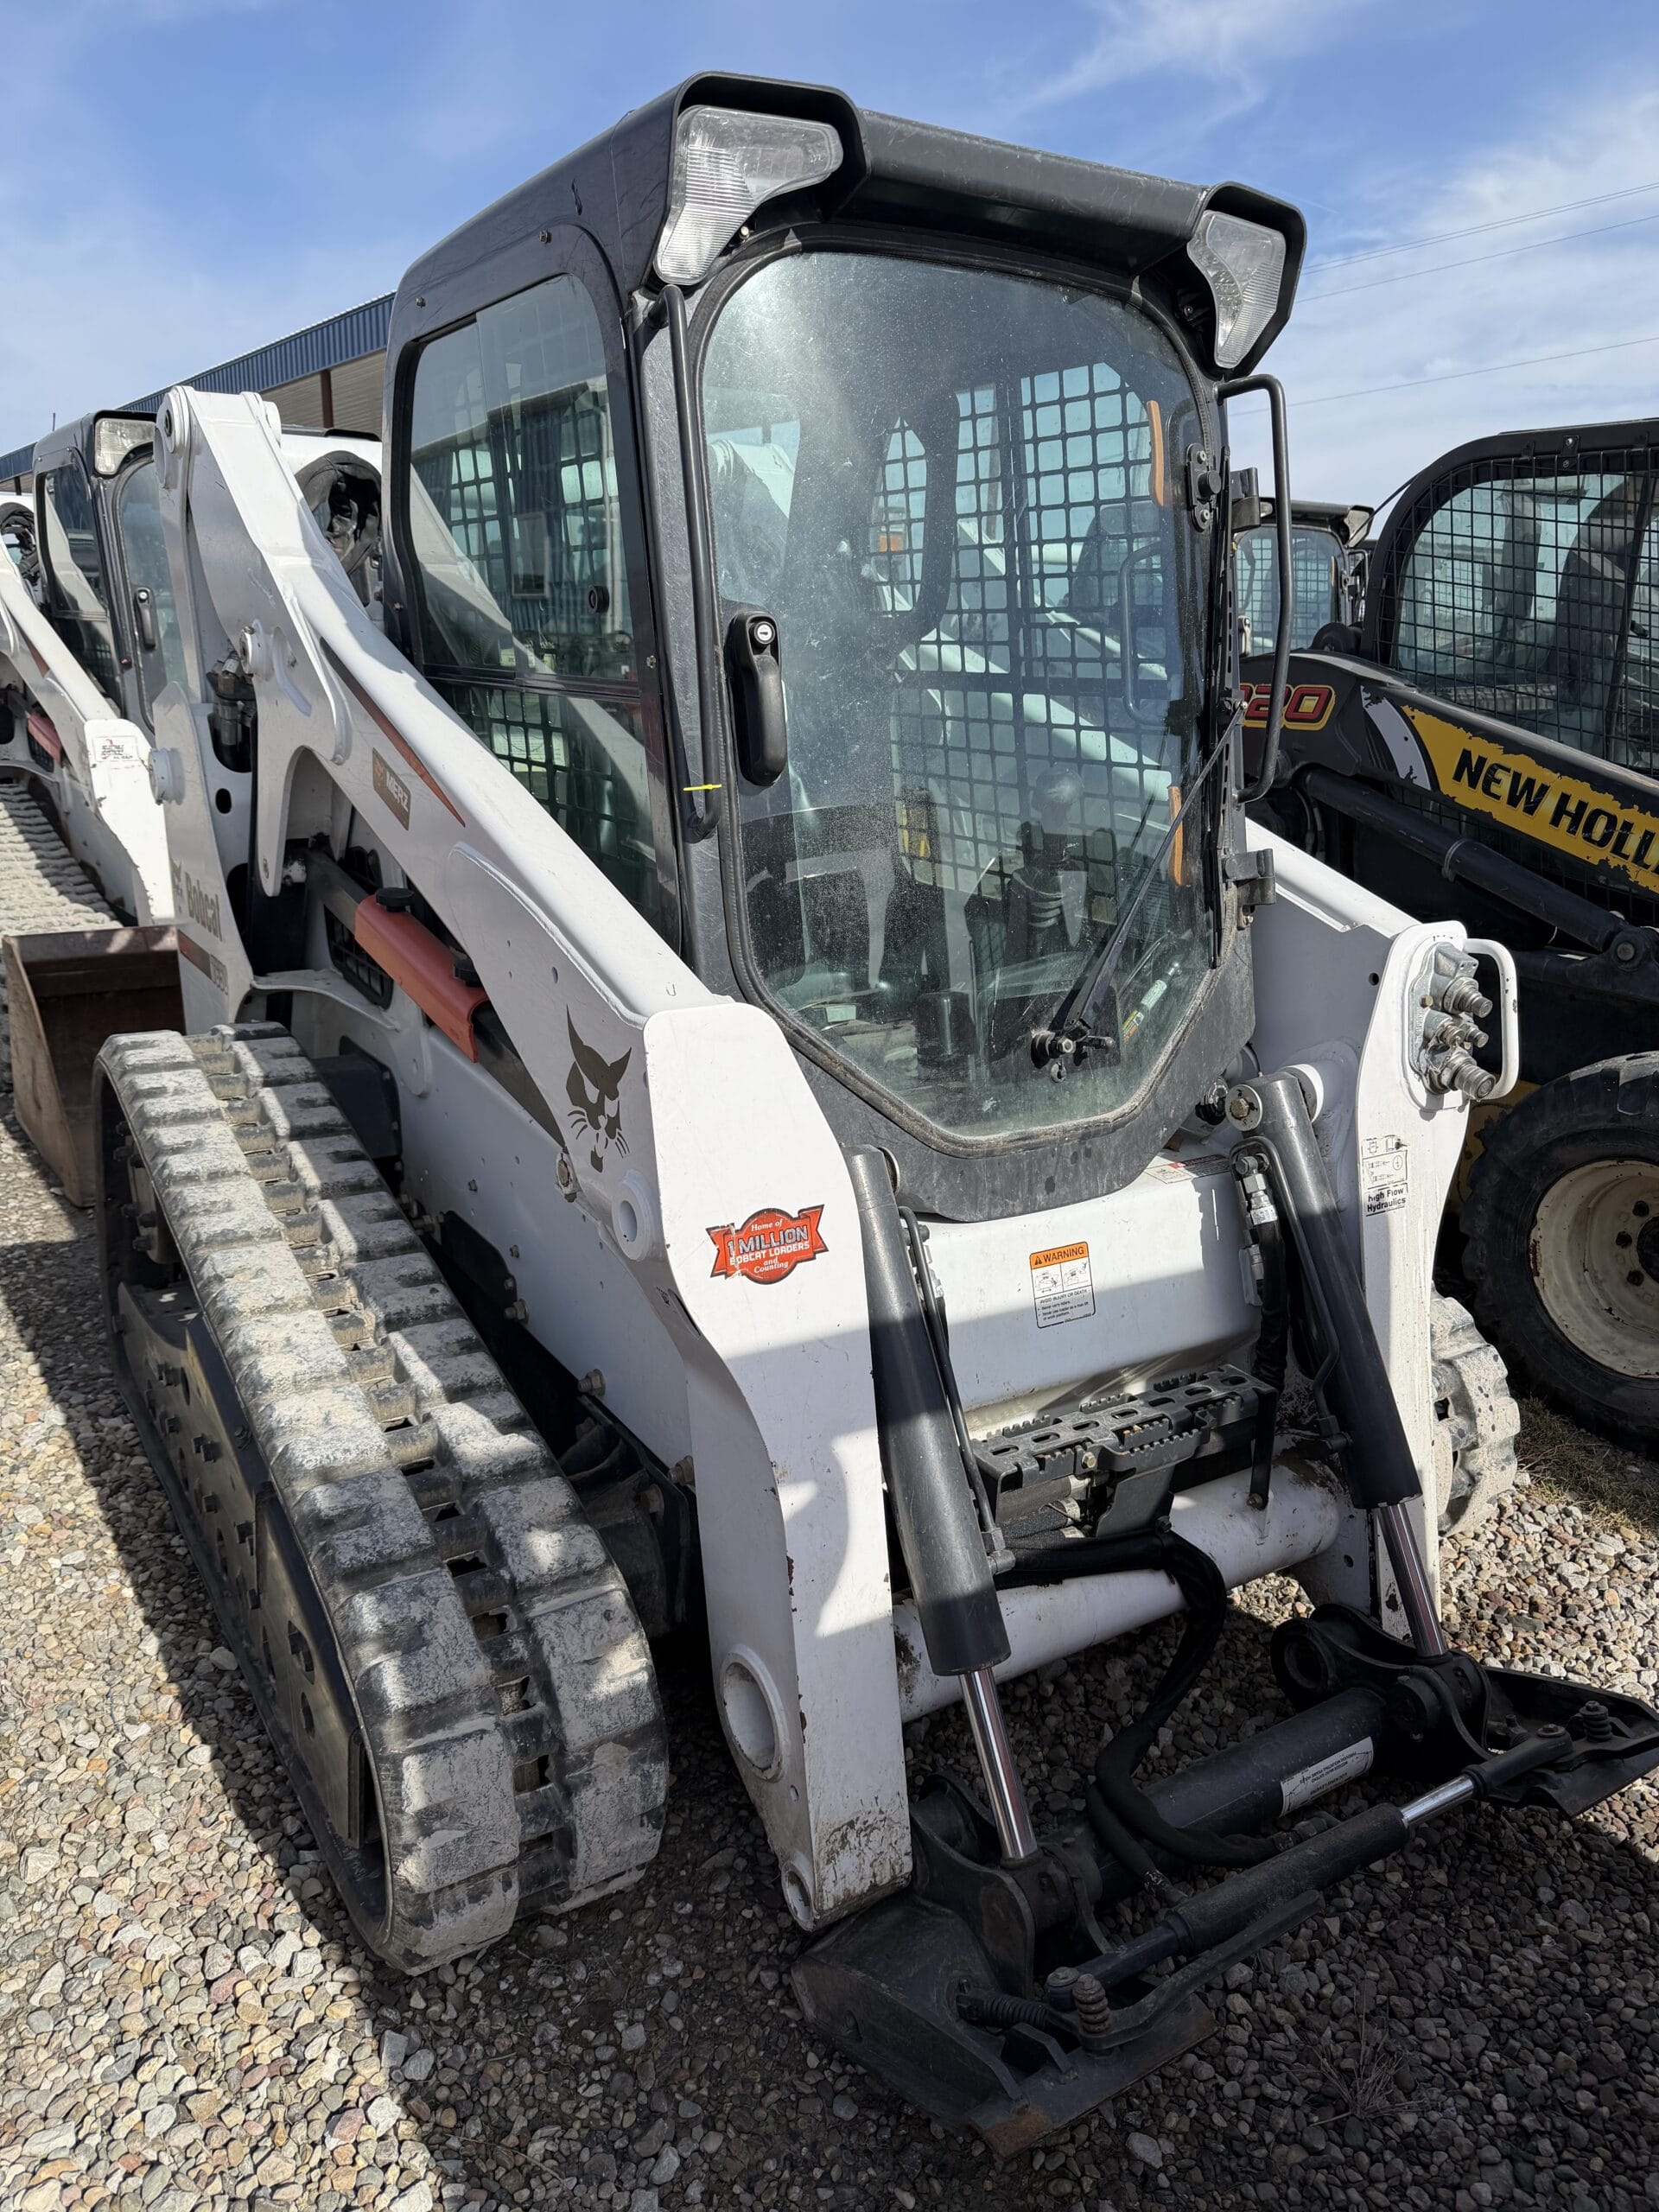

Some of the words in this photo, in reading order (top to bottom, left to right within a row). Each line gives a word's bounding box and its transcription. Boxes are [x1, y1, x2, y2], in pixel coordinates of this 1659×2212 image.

[386, 771, 410, 812] MERZ
[1452, 747, 1551, 817] NEW
[1548, 791, 1659, 876] HOLL
[185, 872, 223, 942] Bobcat
[1367, 1198, 1407, 1212] Hydraulics
[751, 1223, 773, 1232] Home
[775, 1218, 784, 1227] of
[727, 1240, 734, 1256] 1
[738, 1224, 809, 1255] MILLION
[729, 1250, 767, 1266] BOBCAT
[769, 1241, 810, 1256] LOADERS
[763, 1257, 779, 1266] and
[1043, 1246, 1084, 1263] WARNING
[753, 1262, 789, 1274] Counting
